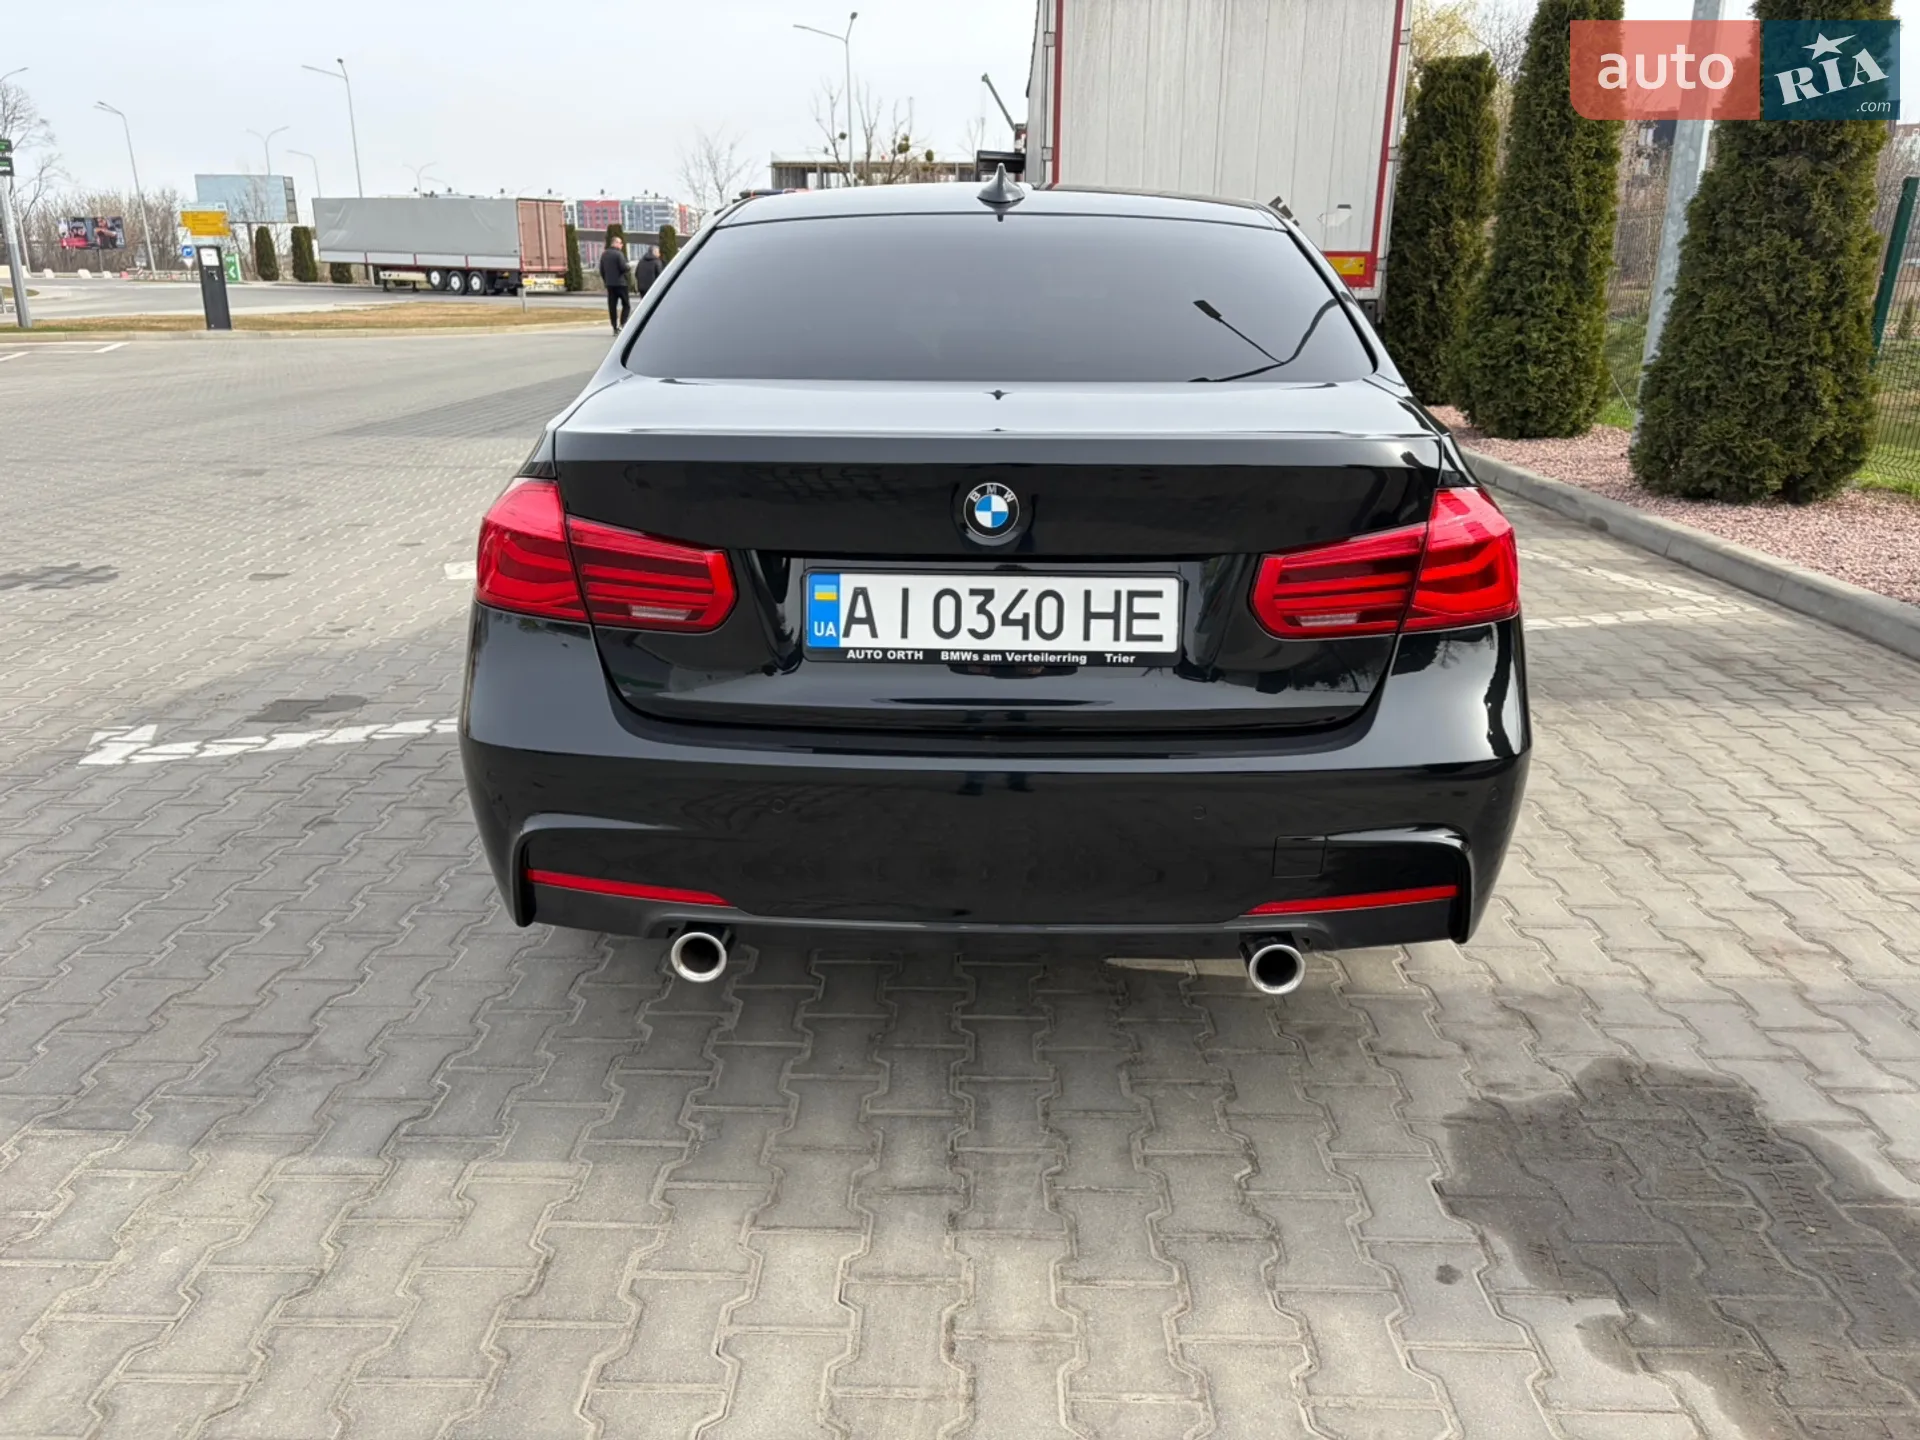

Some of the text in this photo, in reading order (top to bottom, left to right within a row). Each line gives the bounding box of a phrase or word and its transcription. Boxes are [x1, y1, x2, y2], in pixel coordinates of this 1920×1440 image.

[968, 484, 1016, 503] BMW
[842, 586, 1164, 642] AI 0340 HE
[814, 621, 837, 638] UA
[847, 650, 1136, 665] AUTO ORTH BMWs am Verteilerring Trier
